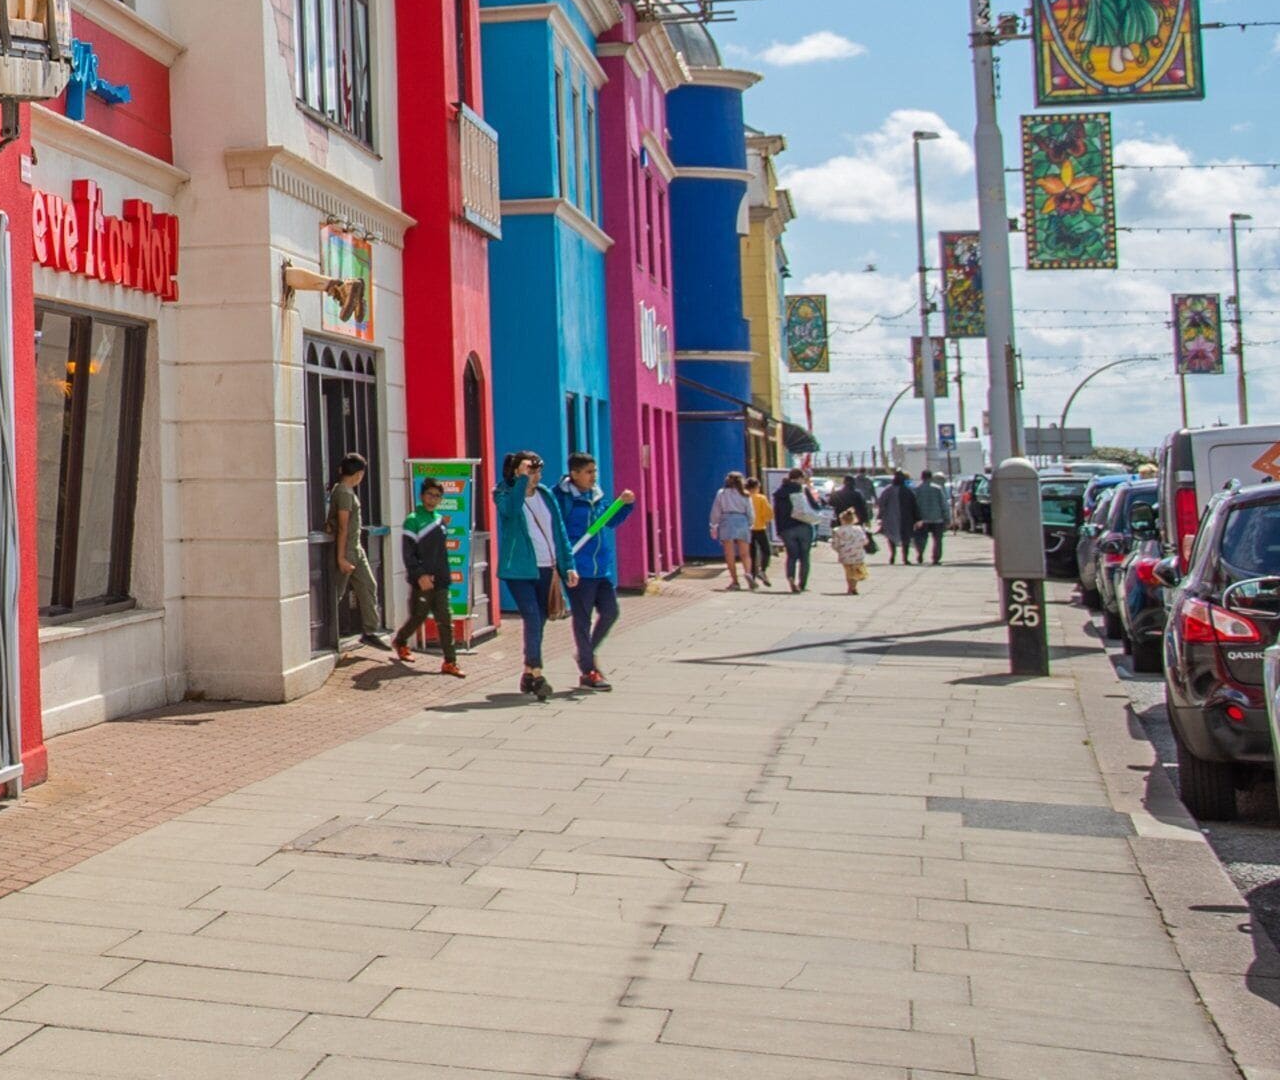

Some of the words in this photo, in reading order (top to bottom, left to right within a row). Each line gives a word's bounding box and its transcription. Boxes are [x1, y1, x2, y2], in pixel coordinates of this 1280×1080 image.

[72, 180, 106, 280] It
[105, 216, 133, 287] or
[123, 199, 179, 301] Not!
[1011, 580, 1028, 602] S
[1008, 603, 1039, 627] 25
[1227, 651, 1266, 660] QASH
